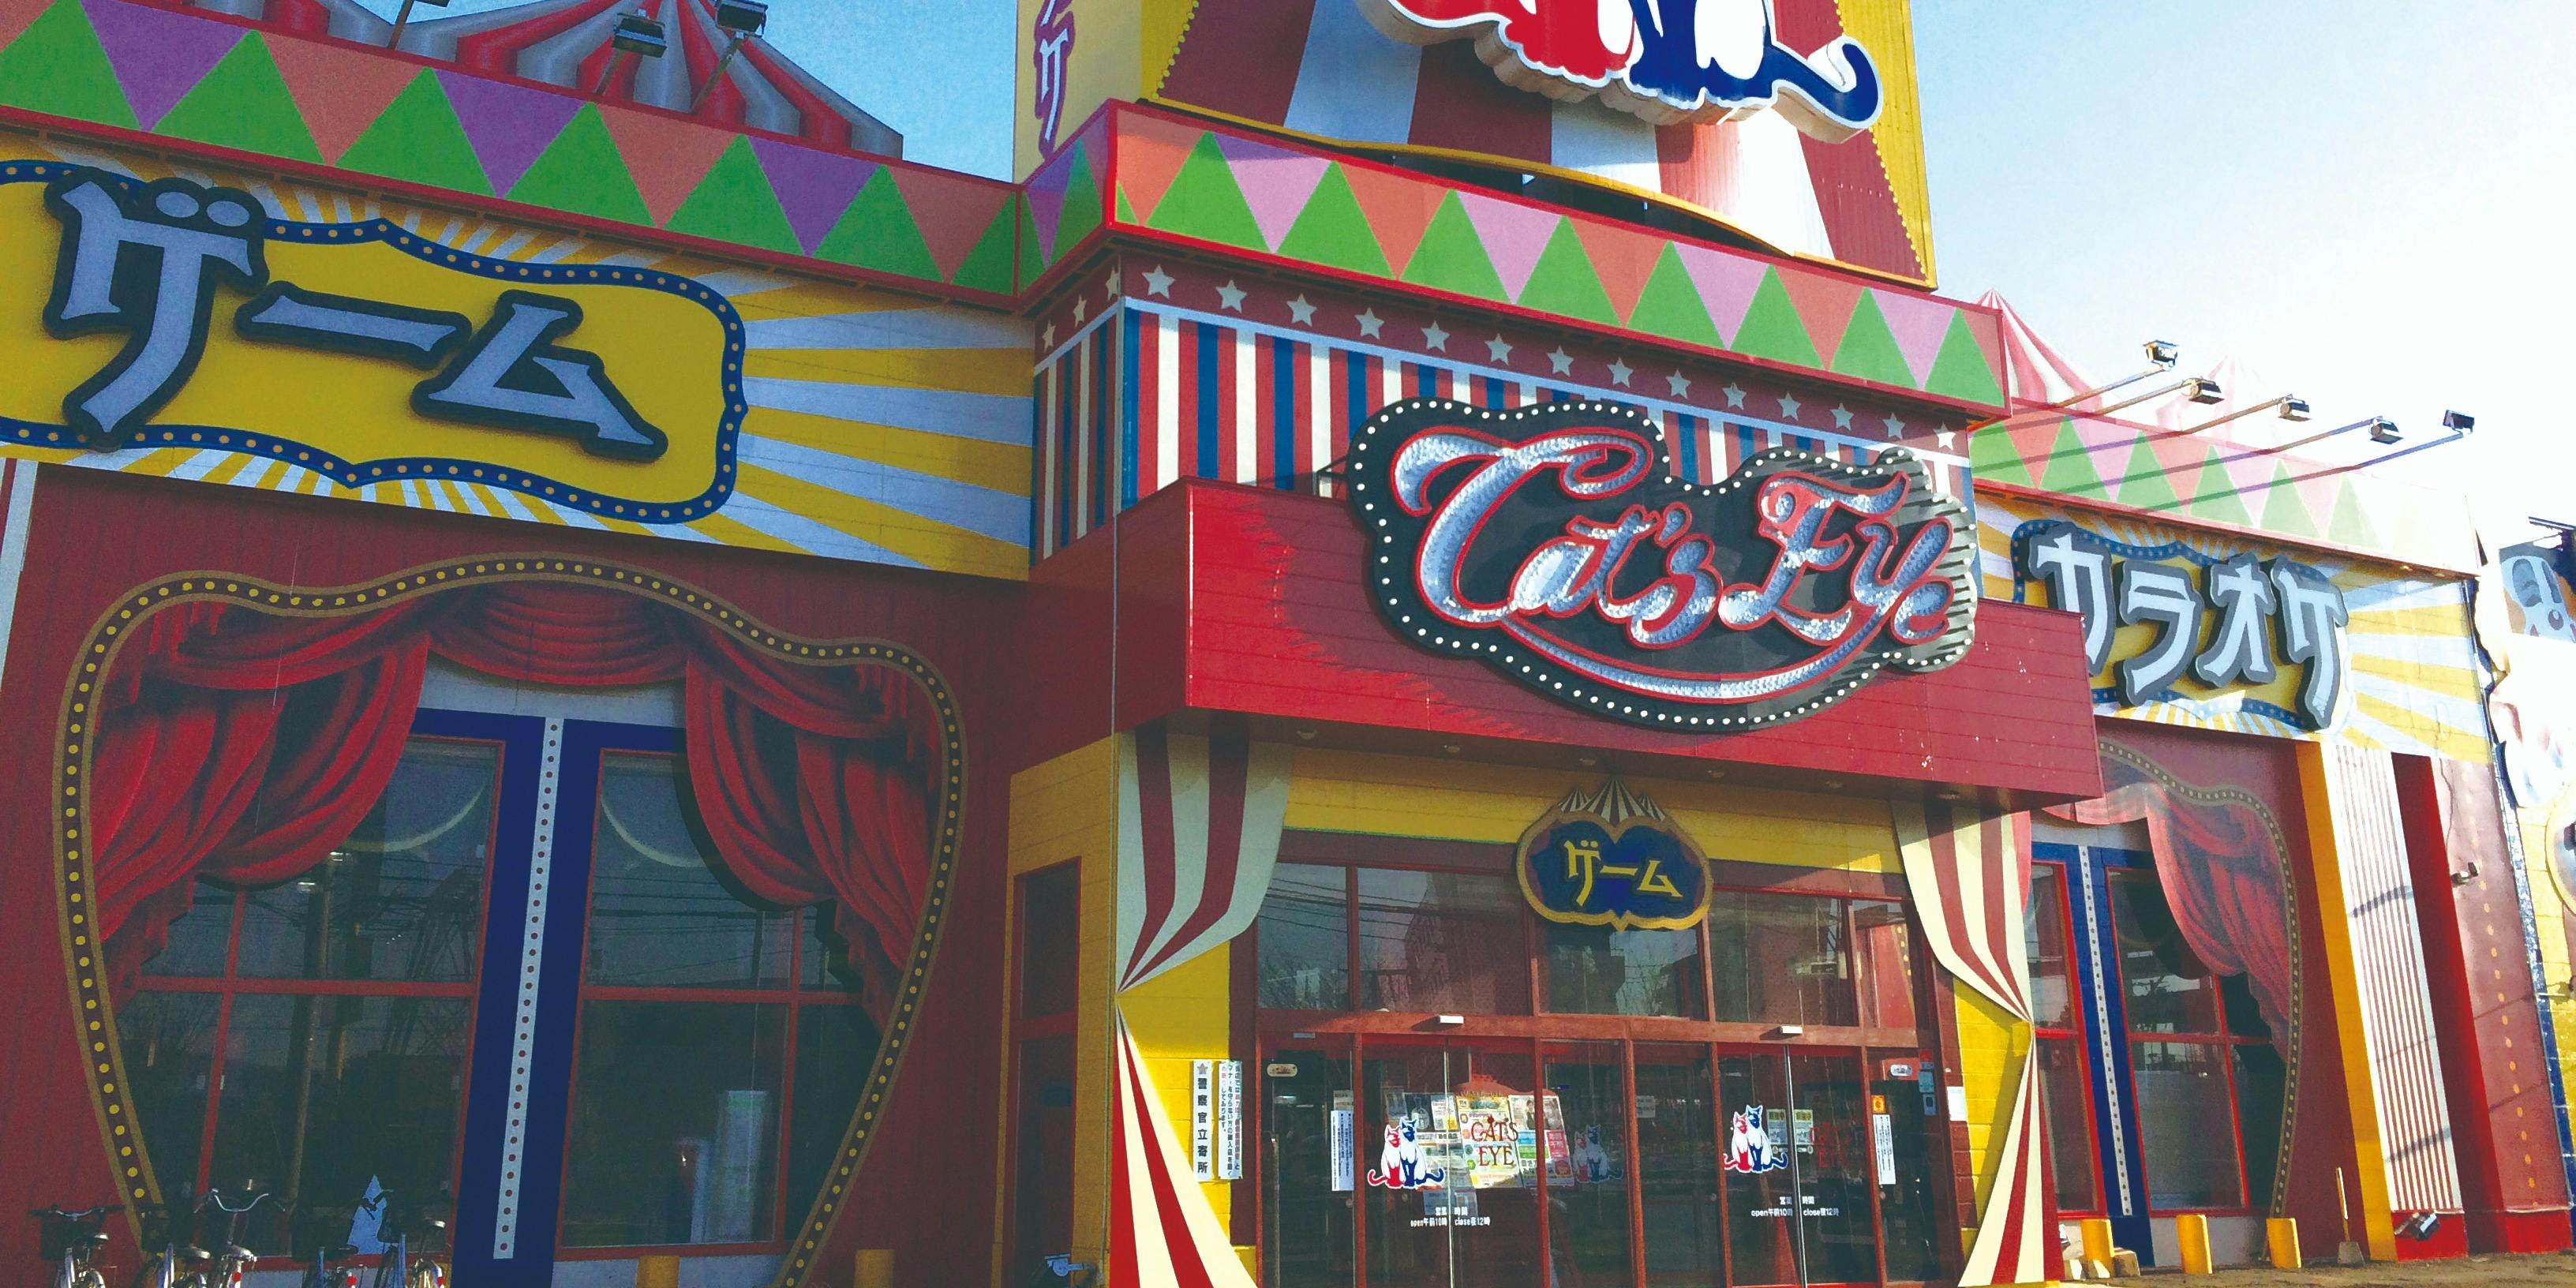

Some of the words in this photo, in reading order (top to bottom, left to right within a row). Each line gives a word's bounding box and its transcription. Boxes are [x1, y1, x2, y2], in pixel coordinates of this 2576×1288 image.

[55, 174, 661, 448] ゲーム
[1391, 426, 1724, 651] Cat's
[1717, 471, 1957, 649] Eye
[2035, 530, 2347, 720] カラオケ
[1562, 839, 1684, 907] ゲーム
[1196, 1077, 1208, 1174] 警察官立寄所
[1478, 1145, 1515, 1166] EYE
